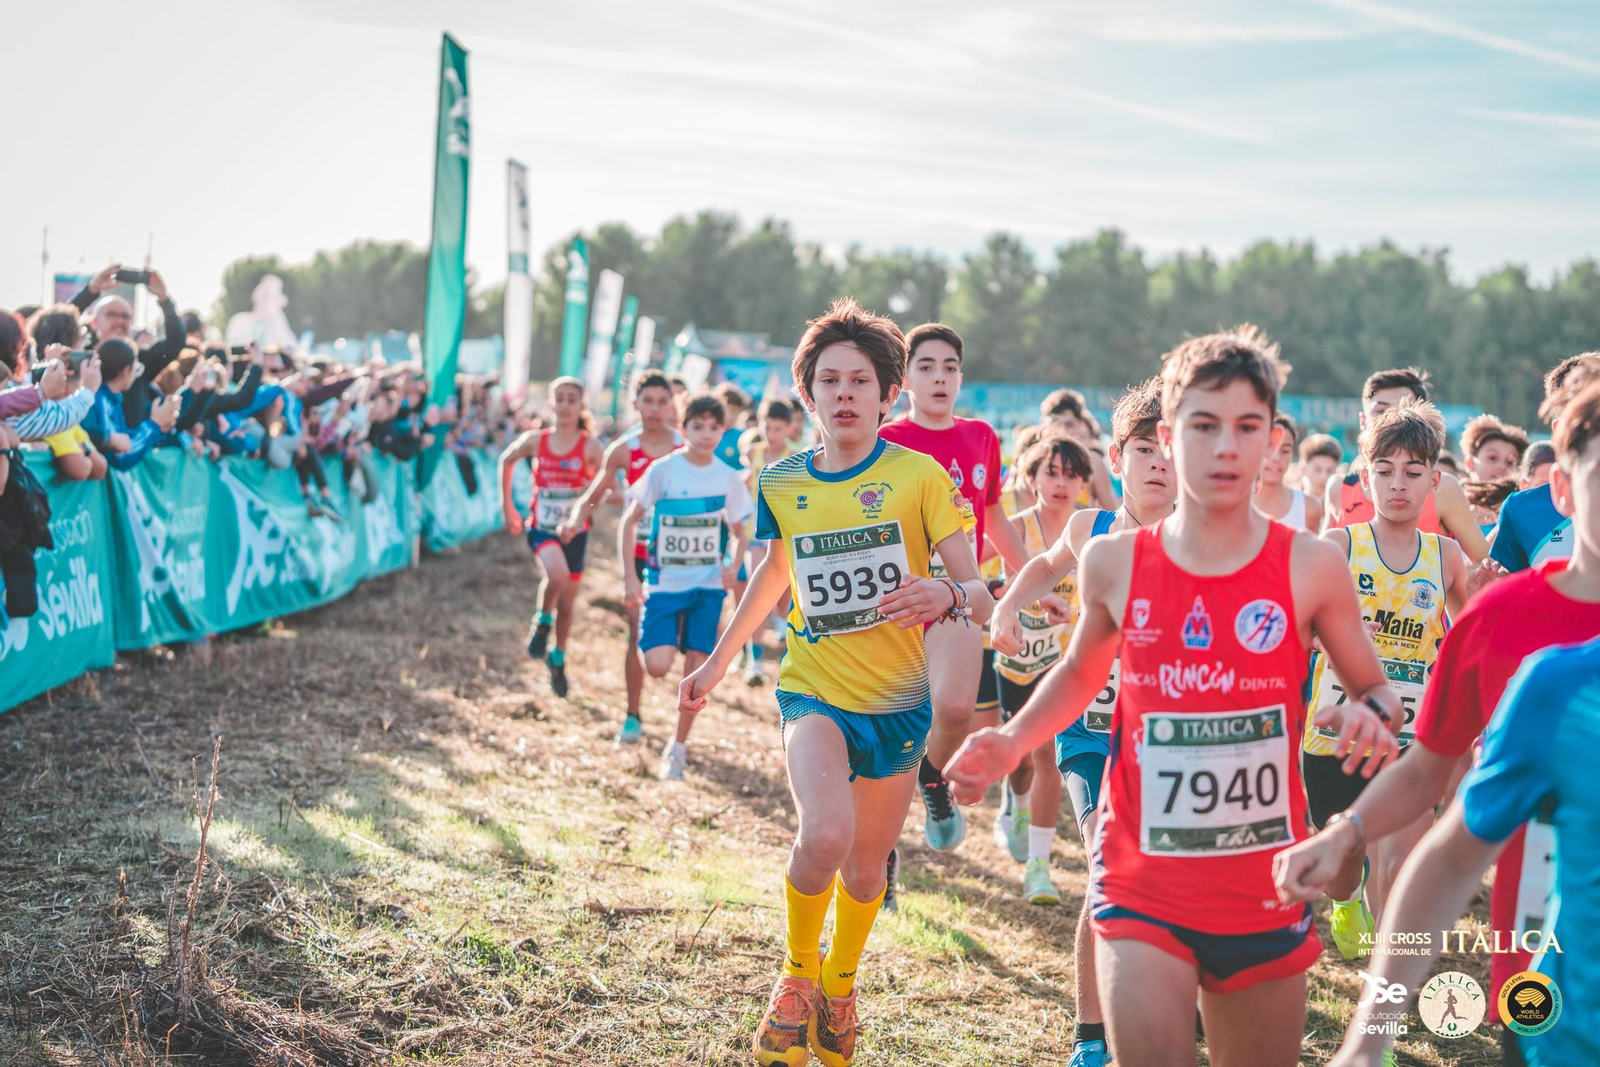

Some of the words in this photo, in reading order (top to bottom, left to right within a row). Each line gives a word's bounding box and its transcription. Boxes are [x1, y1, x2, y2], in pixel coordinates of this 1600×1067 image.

[665, 535, 715, 553] 8016
[820, 531, 872, 549] ITÁLICA
[807, 562, 902, 607] 5939
[1373, 609, 1425, 640] Mafia
[1239, 676, 1287, 691] DENTAL
[1182, 717, 1255, 739] ITÁLICA
[1158, 762, 1279, 815] 7940
